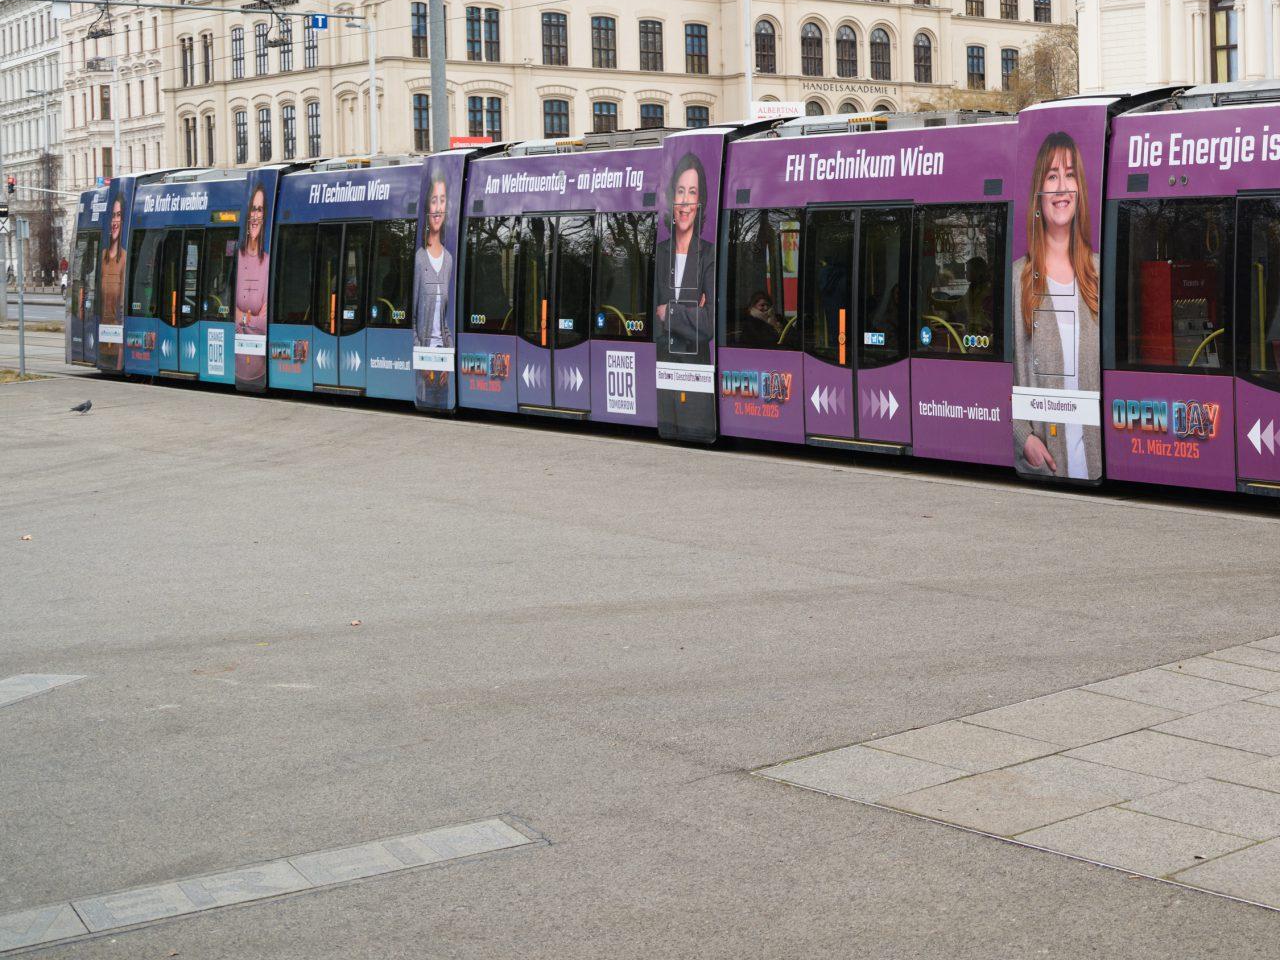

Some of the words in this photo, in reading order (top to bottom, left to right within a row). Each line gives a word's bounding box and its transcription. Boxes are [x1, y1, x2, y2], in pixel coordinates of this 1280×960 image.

[802, 82, 888, 94] HANDELSAKADEMIE
[758, 106, 799, 114] ALBERTINA
[1127, 134, 1162, 168] Die
[1168, 127, 1254, 170] Energie
[785, 153, 805, 182] FH
[809, 149, 895, 180] Technikum
[900, 145, 944, 176] Wien
[485, 175, 500, 194] Am
[502, 170, 567, 194] Weltfrauentag
[577, 172, 590, 190] an
[591, 167, 623, 192] jedem
[626, 167, 644, 191] Tag
[144, 194, 155, 212] Die
[155, 193, 171, 211] Kraft
[171, 192, 180, 211] ist
[180, 191, 208, 210] weiblich
[309, 183, 321, 204] FH
[321, 181, 366, 203] Technikum
[367, 179, 390, 201] Wien
[208, 343, 223, 363] OUR
[608, 354, 634, 369] CHANGE
[608, 371, 634, 398] OUR
[722, 370, 759, 398] OPEN
[761, 370, 792, 401] DAY
[609, 398, 634, 410] TOMORROW
[762, 403, 780, 418] 2025
[919, 400, 1000, 421] technikum-wien.at
[1032, 398, 1043, 410] Eva
[1112, 398, 1168, 433] OPEN
[1172, 401, 1220, 438] DAY
[1132, 438, 1145, 455] 21.
[1147, 439, 1172, 457] März
[1174, 440, 1200, 459] 2025
